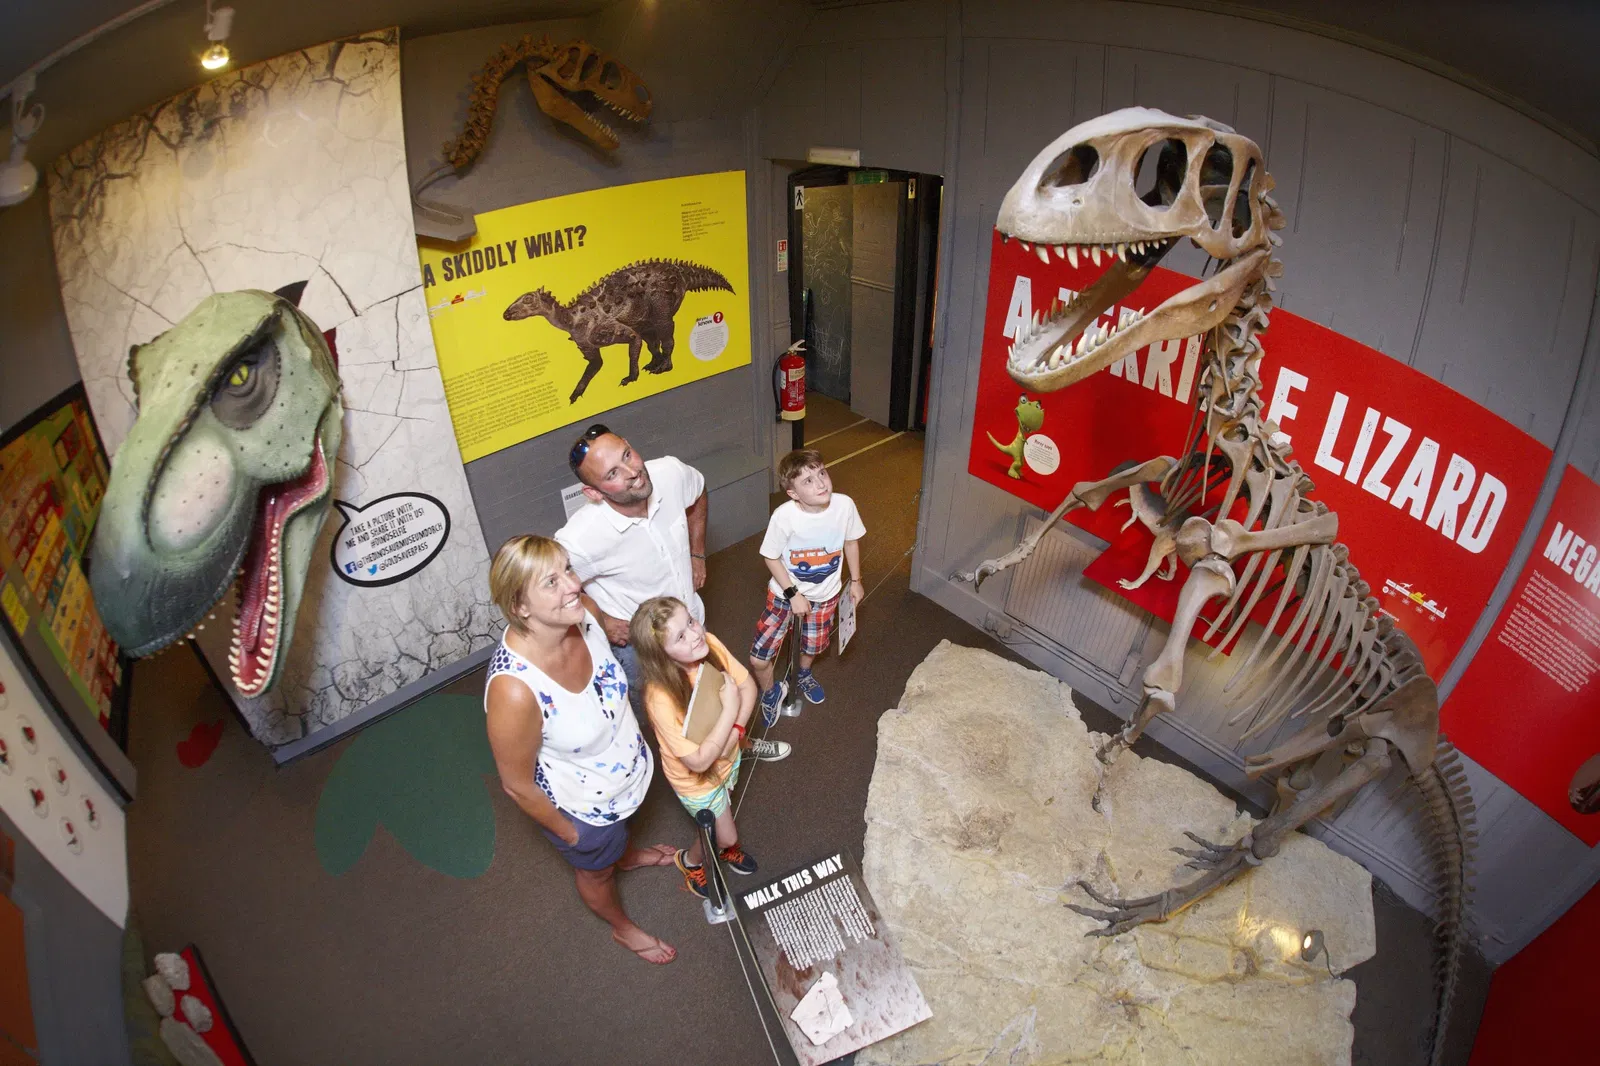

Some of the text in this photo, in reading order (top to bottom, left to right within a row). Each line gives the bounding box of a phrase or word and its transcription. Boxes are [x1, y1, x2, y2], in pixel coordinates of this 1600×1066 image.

[424, 225, 587, 289] A SKIDDLY WHAT?
[1003, 275, 1032, 339] A
[1314, 391, 1507, 553] LIZARD
[345, 538, 356, 550] ME
[357, 532, 370, 544] AND
[370, 523, 390, 538] SHARE
[397, 512, 414, 526] WITH
[350, 524, 365, 536] TAKE
[372, 510, 395, 525] PICTURE
[396, 502, 414, 516] WITH
[370, 525, 407, 548] #DINOSELFIE
[1543, 521, 1600, 600] MEGA
[743, 853, 844, 910] WALK THIS WAY
